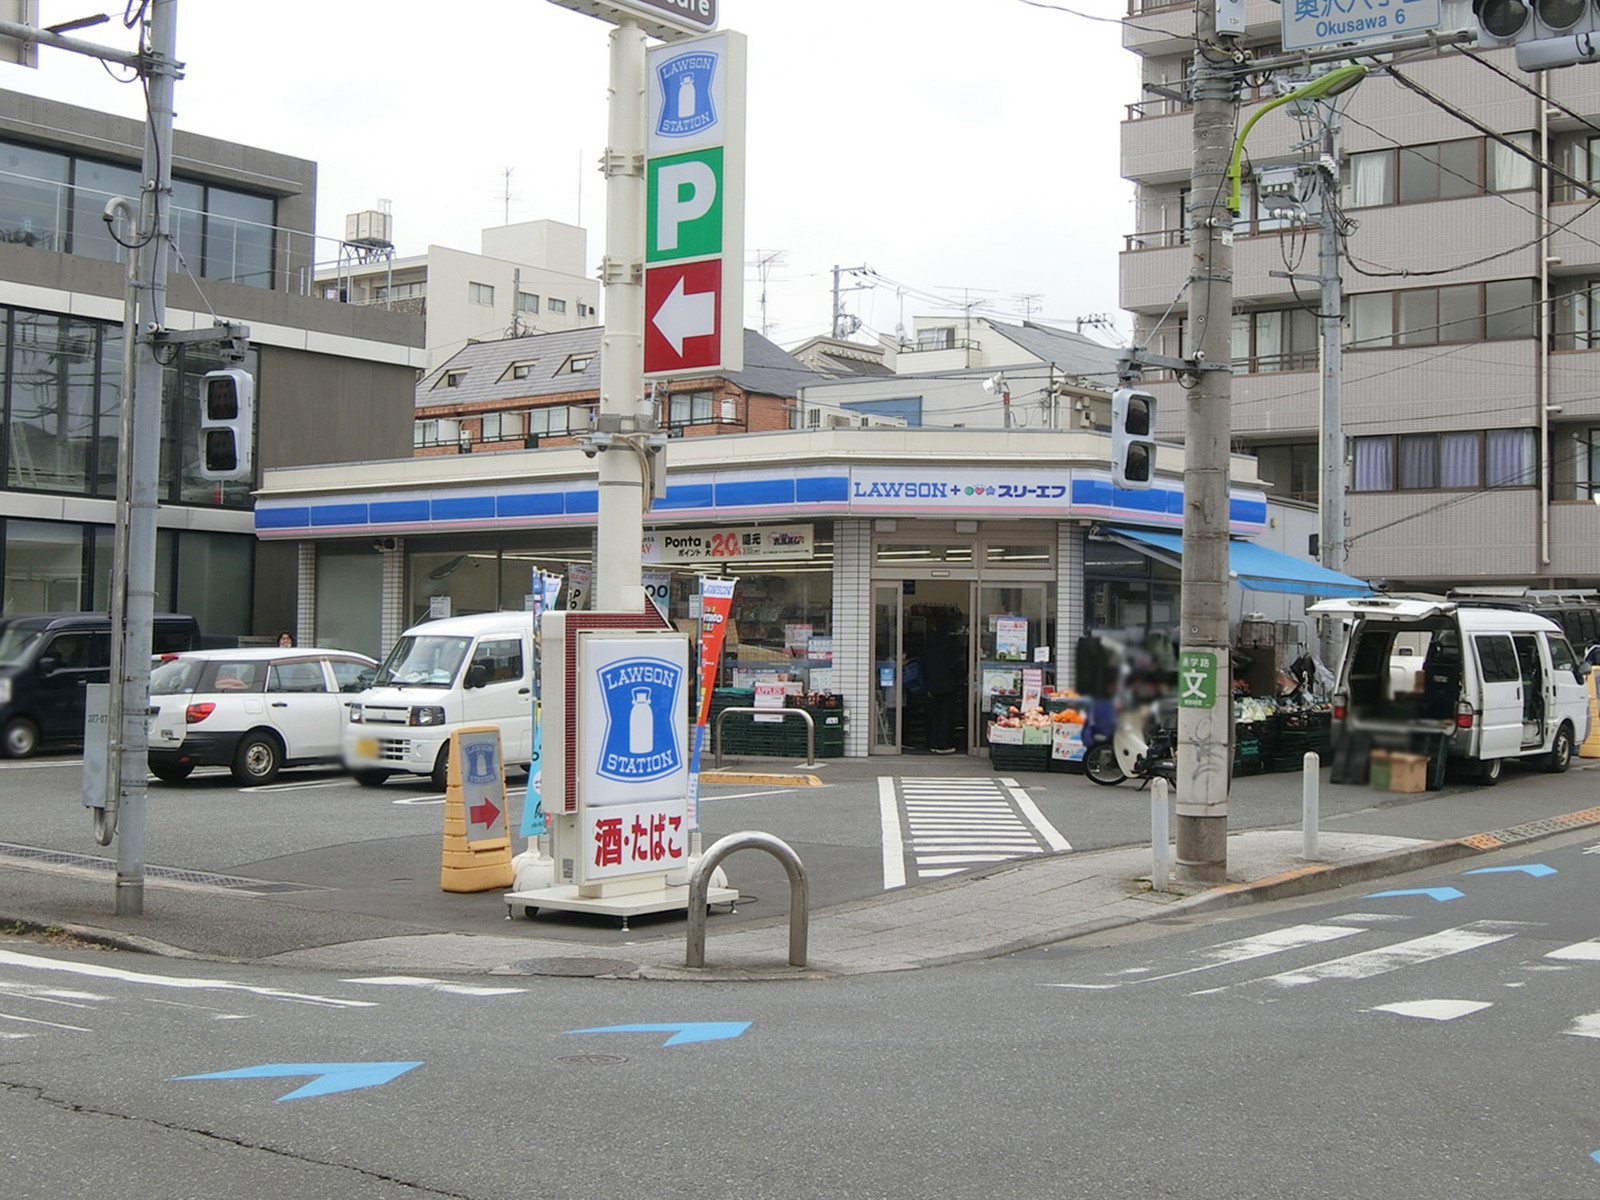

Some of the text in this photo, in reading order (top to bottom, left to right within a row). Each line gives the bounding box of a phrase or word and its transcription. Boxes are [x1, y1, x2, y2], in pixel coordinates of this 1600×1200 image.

[666, 0, 710, 16] are
[1316, 8, 1405, 37] Okusawa 6
[662, 57, 712, 78] LAWSON
[662, 111, 711, 131] STATION
[656, 161, 717, 251] P
[854, 482, 1066, 498] LAWSON スリーエフ
[664, 535, 702, 548] Ponta
[678, 548, 701, 557] ポイント
[606, 666, 675, 690] LAWSON
[606, 749, 674, 774] STATION
[594, 813, 683, 867] 酒・たばこ
